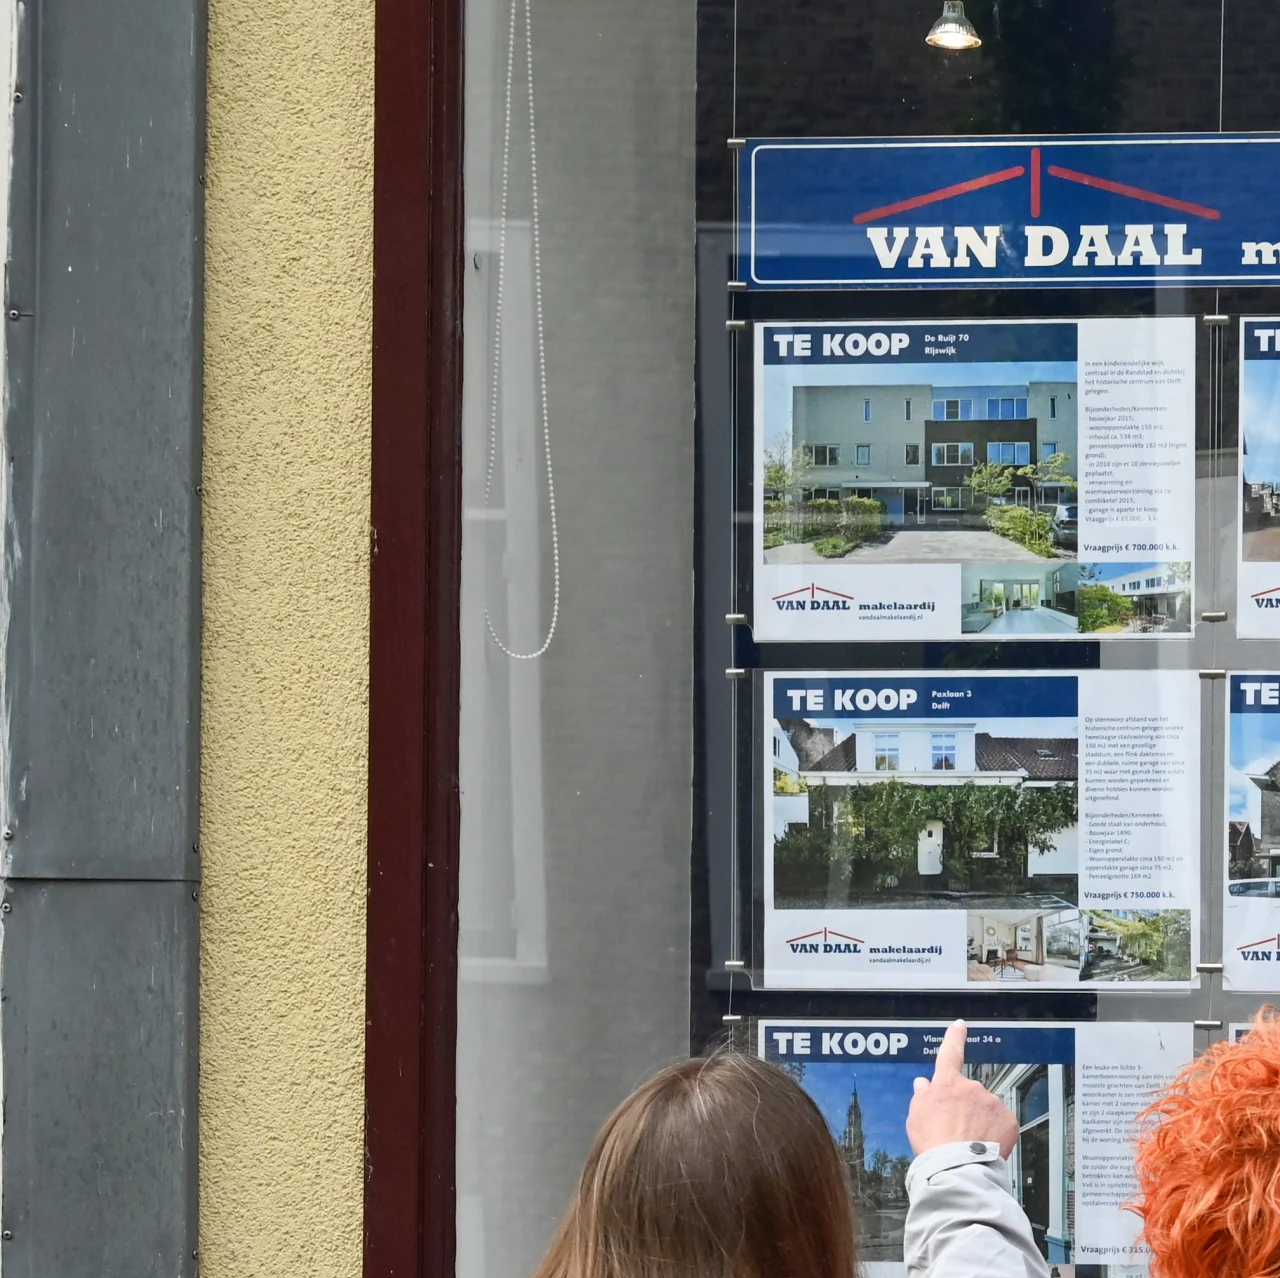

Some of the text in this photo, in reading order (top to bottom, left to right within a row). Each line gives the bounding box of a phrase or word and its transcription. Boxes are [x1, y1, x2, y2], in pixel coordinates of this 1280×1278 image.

[866, 227, 1001, 269] VAN
[1024, 224, 1203, 266] DAAL
[773, 333, 909, 357] TE KOOP
[924, 334, 934, 342] De
[958, 334, 969, 342] 70
[925, 346, 956, 355] Rijswijk
[932, 690, 972, 699] Paxlaan 3
[1240, 683, 1279, 705] TE
[932, 702, 950, 710] Delft
[773, 1032, 908, 1055] TE KOOP
